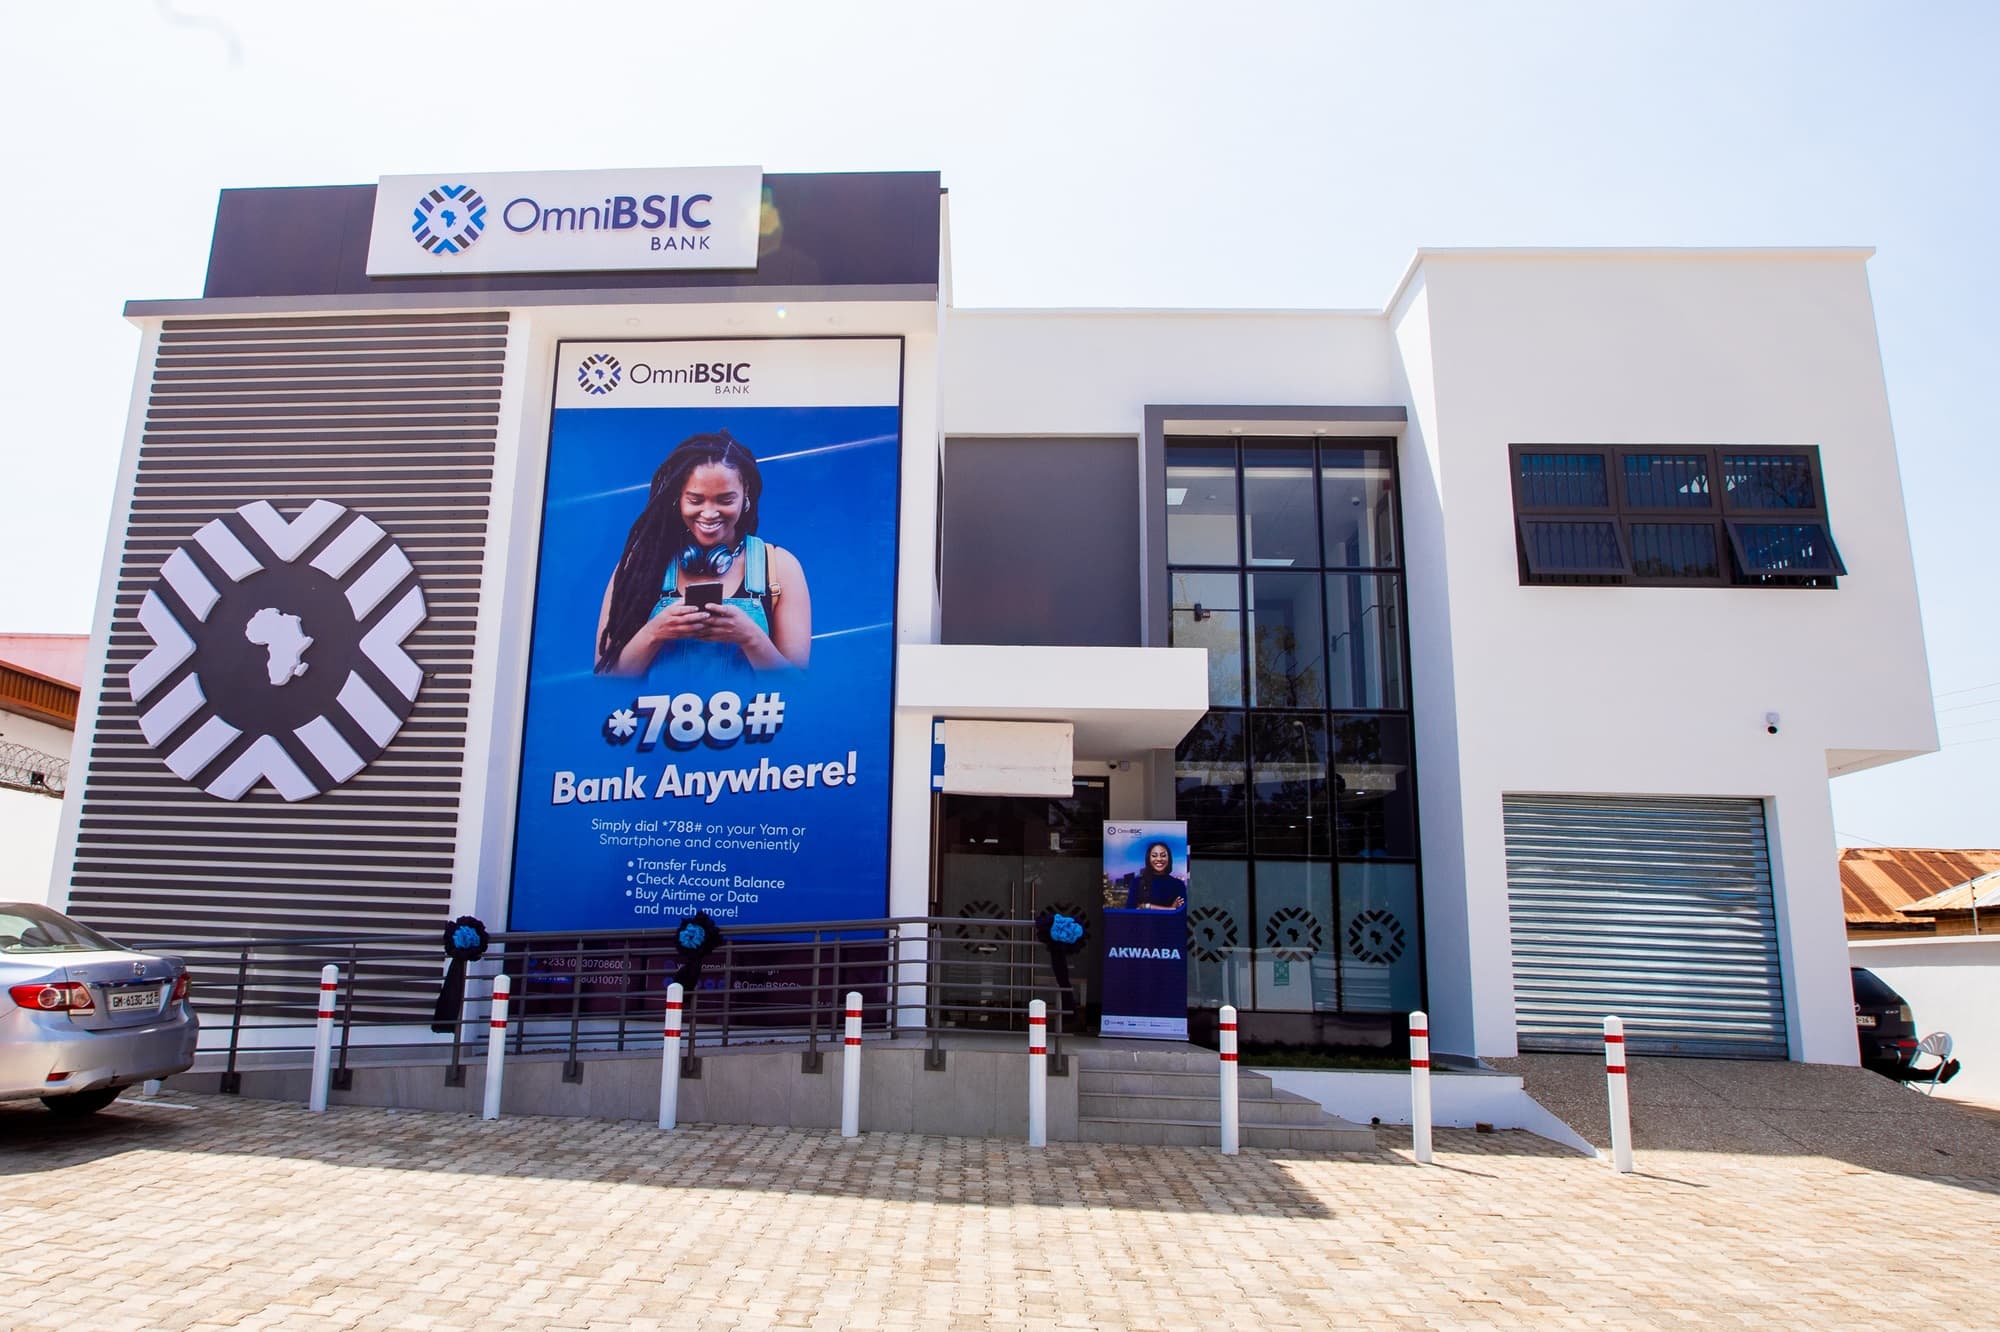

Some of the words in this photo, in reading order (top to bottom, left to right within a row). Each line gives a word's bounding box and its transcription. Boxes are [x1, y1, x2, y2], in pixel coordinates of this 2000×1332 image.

[502, 193, 713, 233] OmniBSIC
[650, 235, 711, 252] BANK
[629, 362, 751, 385] OmniBSIC
[713, 384, 751, 395] BANK
[552, 766, 647, 804] Bank
[654, 750, 857, 804] Anywhere!
[591, 818, 632, 834] Simply
[634, 819, 659, 832] dial
[705, 824, 724, 834] on
[726, 825, 757, 837] your
[759, 823, 789, 836] Yam
[791, 826, 807, 837] or
[599, 832, 682, 849] Smartphone
[684, 836, 712, 849] and
[714, 838, 801, 854] conveniently
[636, 857, 688, 871] Transfer
[690, 859, 727, 873] Funds
[635, 872, 675, 886] Check
[677, 873, 731, 888] Account
[733, 875, 785, 889] Balance
[635, 886, 658, 903] Buy
[660, 887, 706, 902] Airtime
[709, 892, 725, 902] or
[727, 890, 759, 903] Data
[633, 902, 660, 915] and
[663, 903, 698, 916] much
[701, 905, 739, 918] more!
[1108, 946, 1181, 960] AKWAABA
